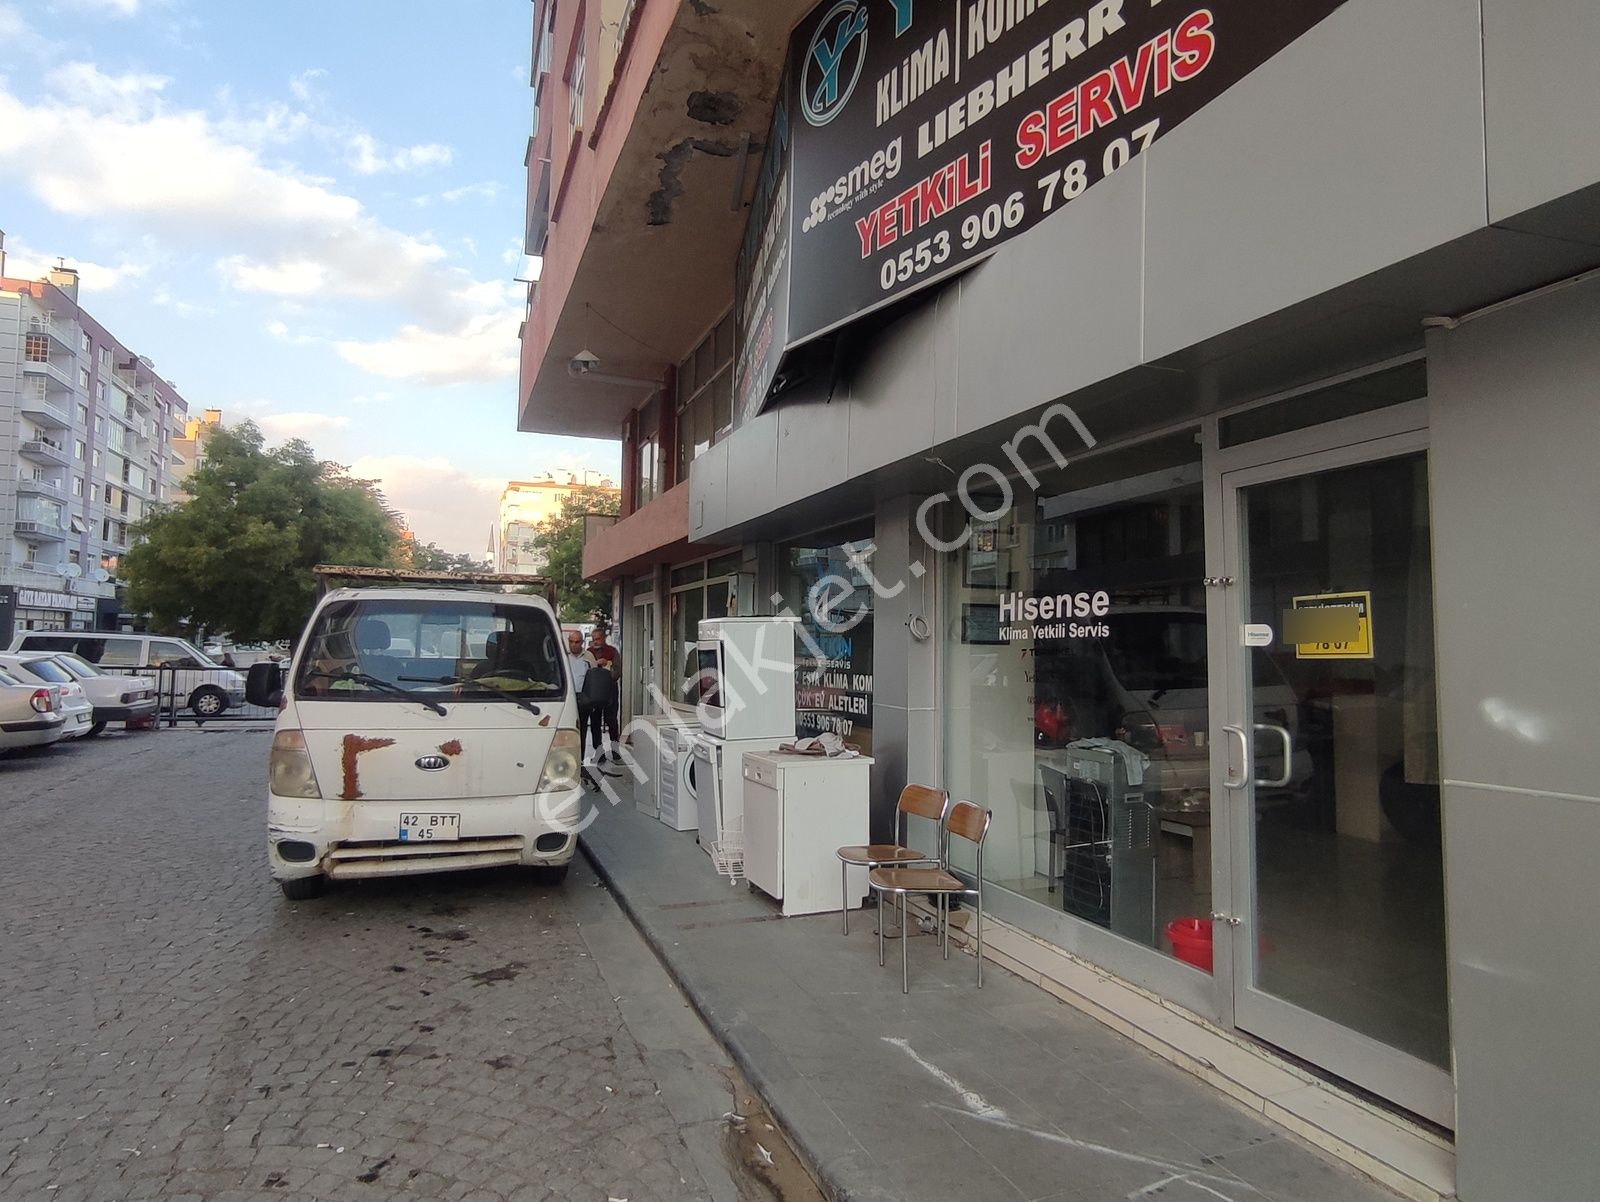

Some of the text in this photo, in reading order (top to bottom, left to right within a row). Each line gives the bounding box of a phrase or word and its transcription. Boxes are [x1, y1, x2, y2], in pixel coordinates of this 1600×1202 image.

[967, 0, 1050, 60] KOM
[917, 0, 1126, 159] LIEBHERR
[833, 135, 902, 205] smeg
[880, 117, 1161, 290] 0553 906 78 07
[999, 590, 1111, 623] Hisense
[999, 621, 1111, 641] Klima Yetkili Servis
[823, 668, 849, 690] KLİMA
[852, 673, 874, 692] KOM
[815, 692, 825, 708] EV
[828, 693, 868, 715] ALETLERİ
[816, 714, 831, 732] 906
[831, 717, 842, 735] 78
[842, 719, 854, 737] 07
[420, 757, 445, 769] KIA
[403, 815, 457, 827] 42 BTT
[418, 828, 433, 839] 45
